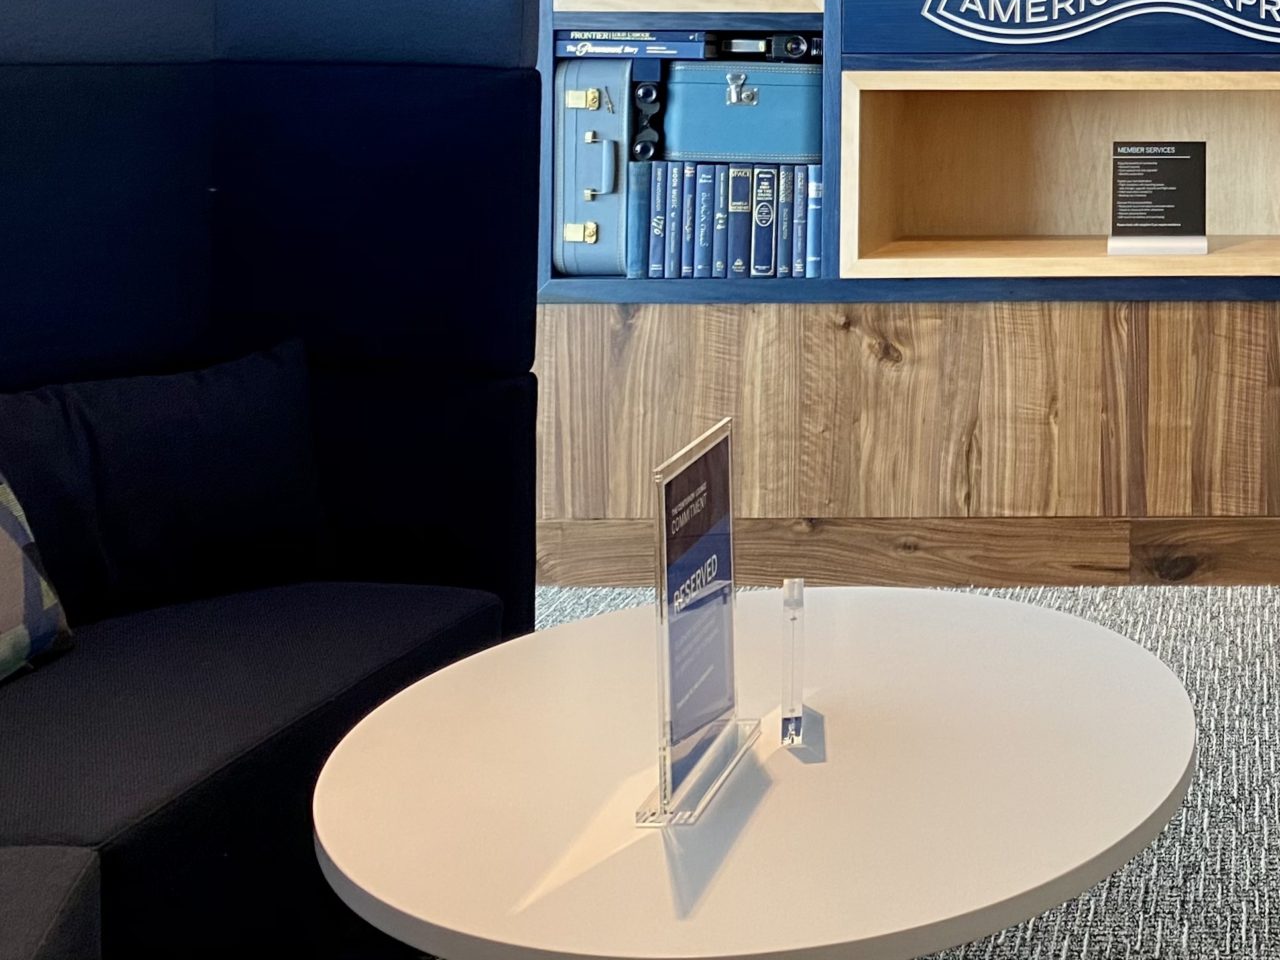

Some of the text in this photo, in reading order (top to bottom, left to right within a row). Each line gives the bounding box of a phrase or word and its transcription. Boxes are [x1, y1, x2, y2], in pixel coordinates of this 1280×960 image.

[571, 31, 609, 39] FRONTIER
[624, 46, 638, 54] Story
[652, 216, 664, 237] 1776
[672, 492, 707, 535] COMMITMENT
[674, 554, 718, 613] RESERVED
